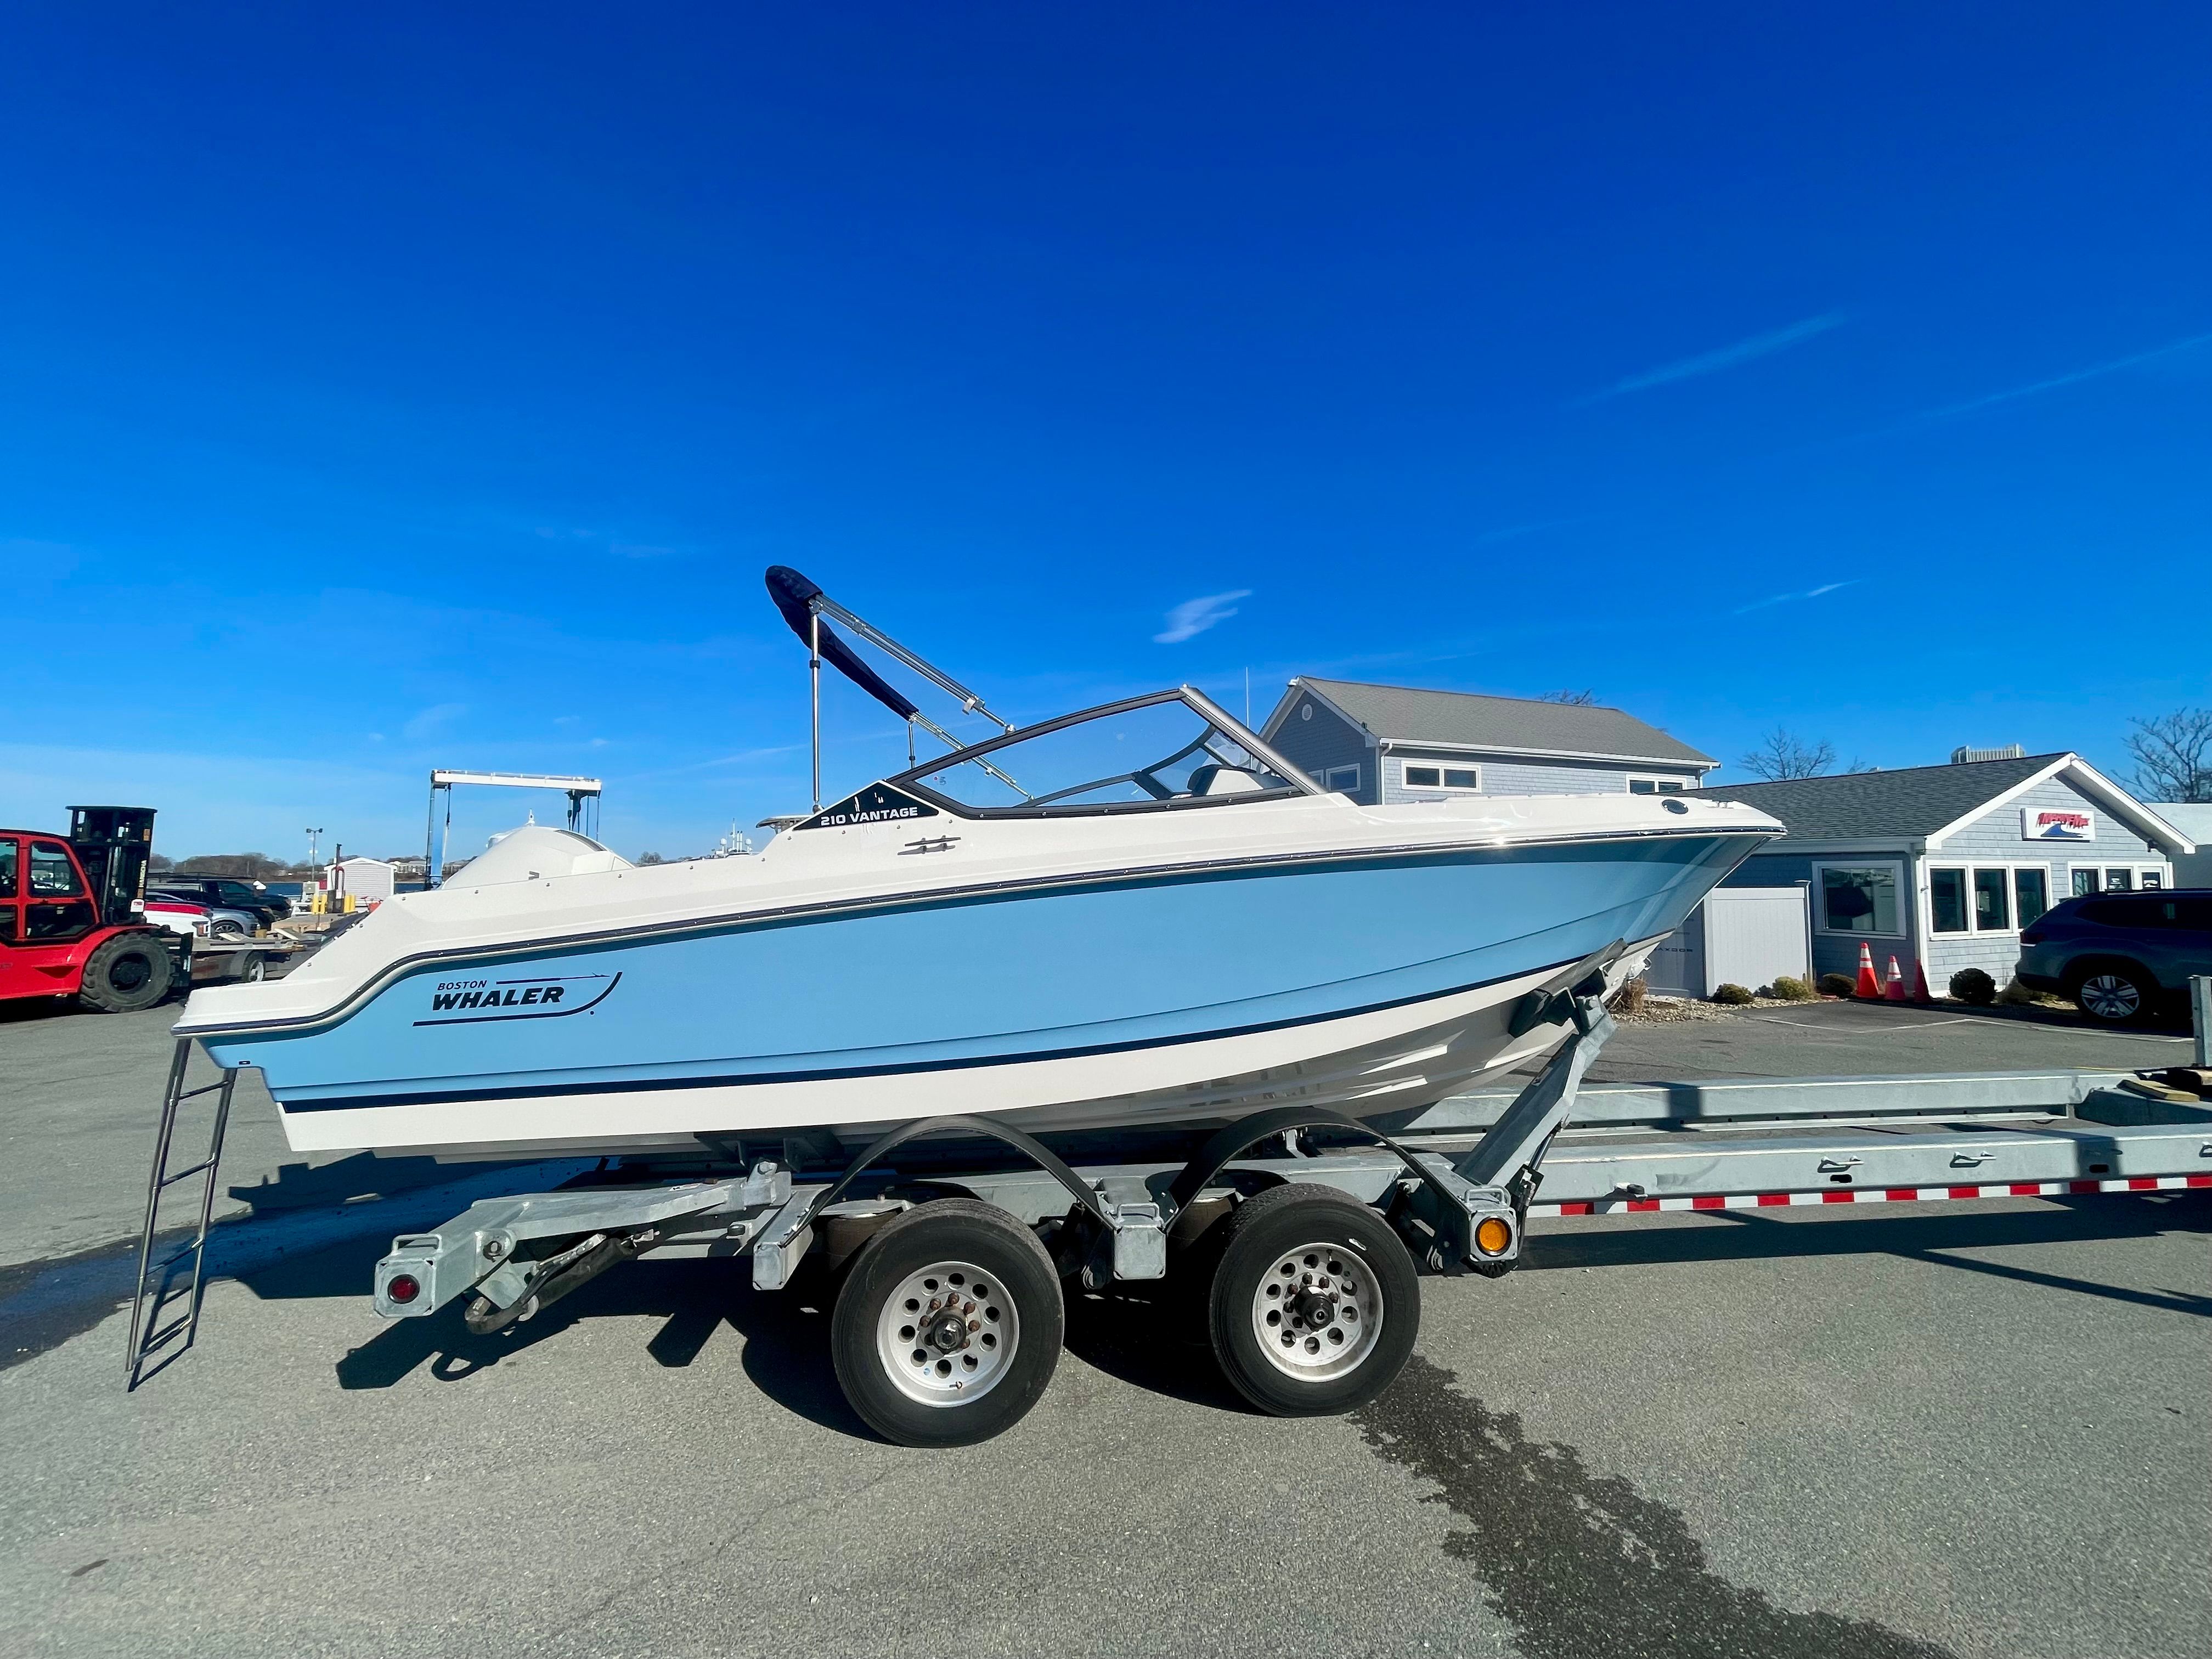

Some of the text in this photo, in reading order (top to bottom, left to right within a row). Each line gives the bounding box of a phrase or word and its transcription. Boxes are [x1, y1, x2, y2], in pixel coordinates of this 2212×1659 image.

[821, 806, 918, 826] 210 VANTAGE
[437, 980, 487, 991] BOSTON
[432, 986, 565, 1011] WHALER
